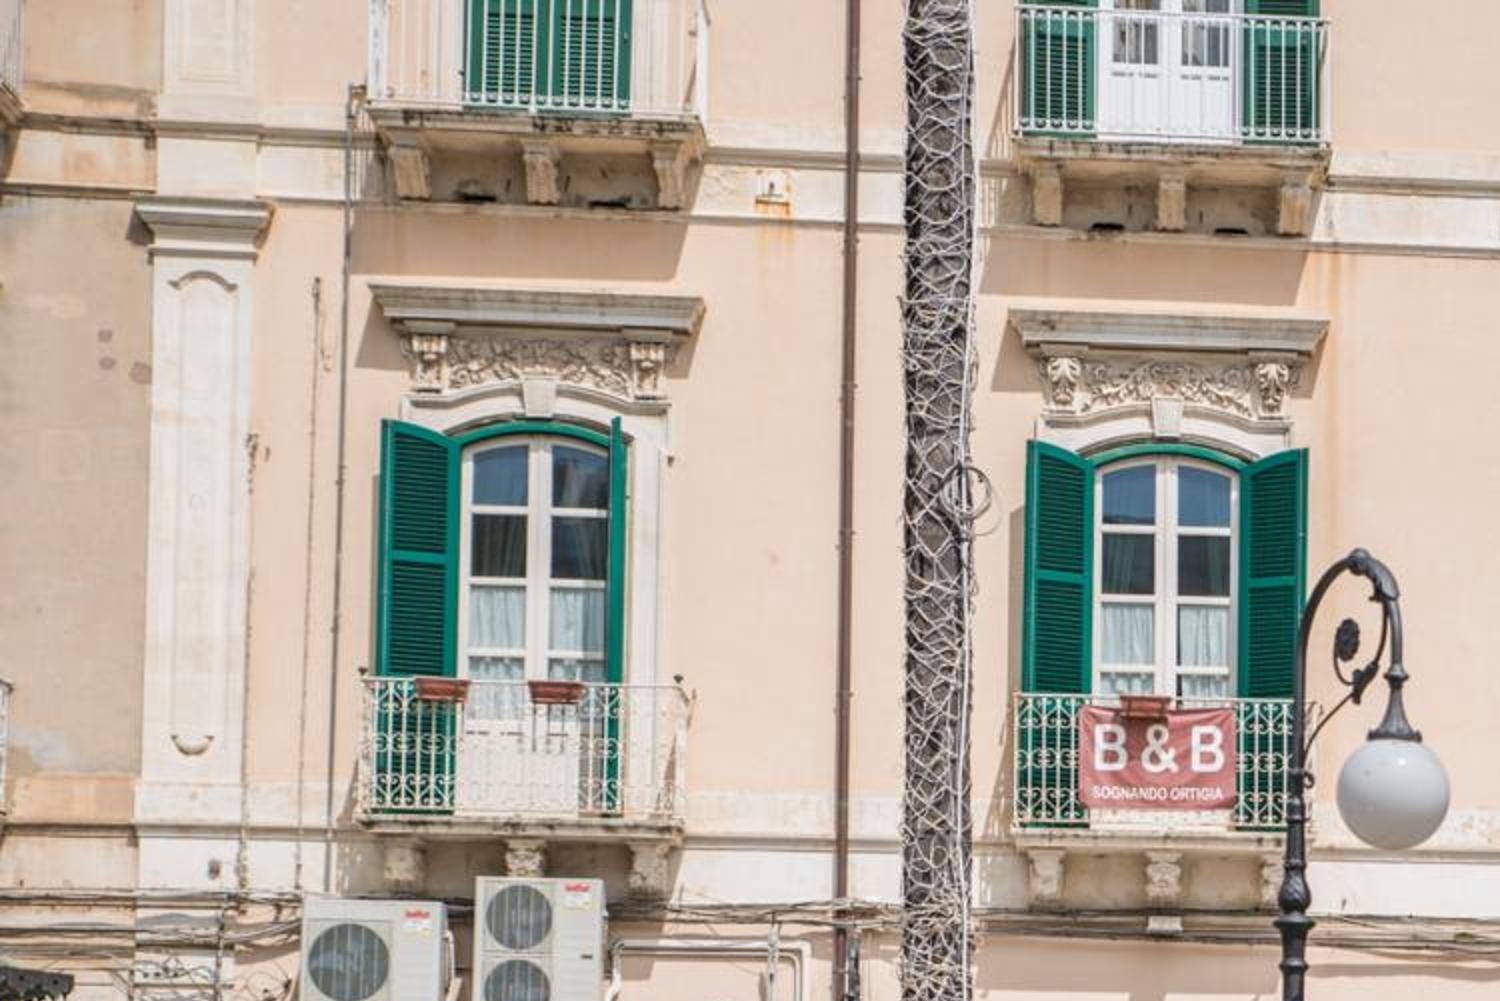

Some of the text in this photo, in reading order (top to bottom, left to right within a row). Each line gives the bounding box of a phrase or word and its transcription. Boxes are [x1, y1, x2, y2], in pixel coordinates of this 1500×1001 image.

[1093, 723, 1225, 773] B & B
[1092, 785, 1224, 800] SOGNANDO ORTIGIA
